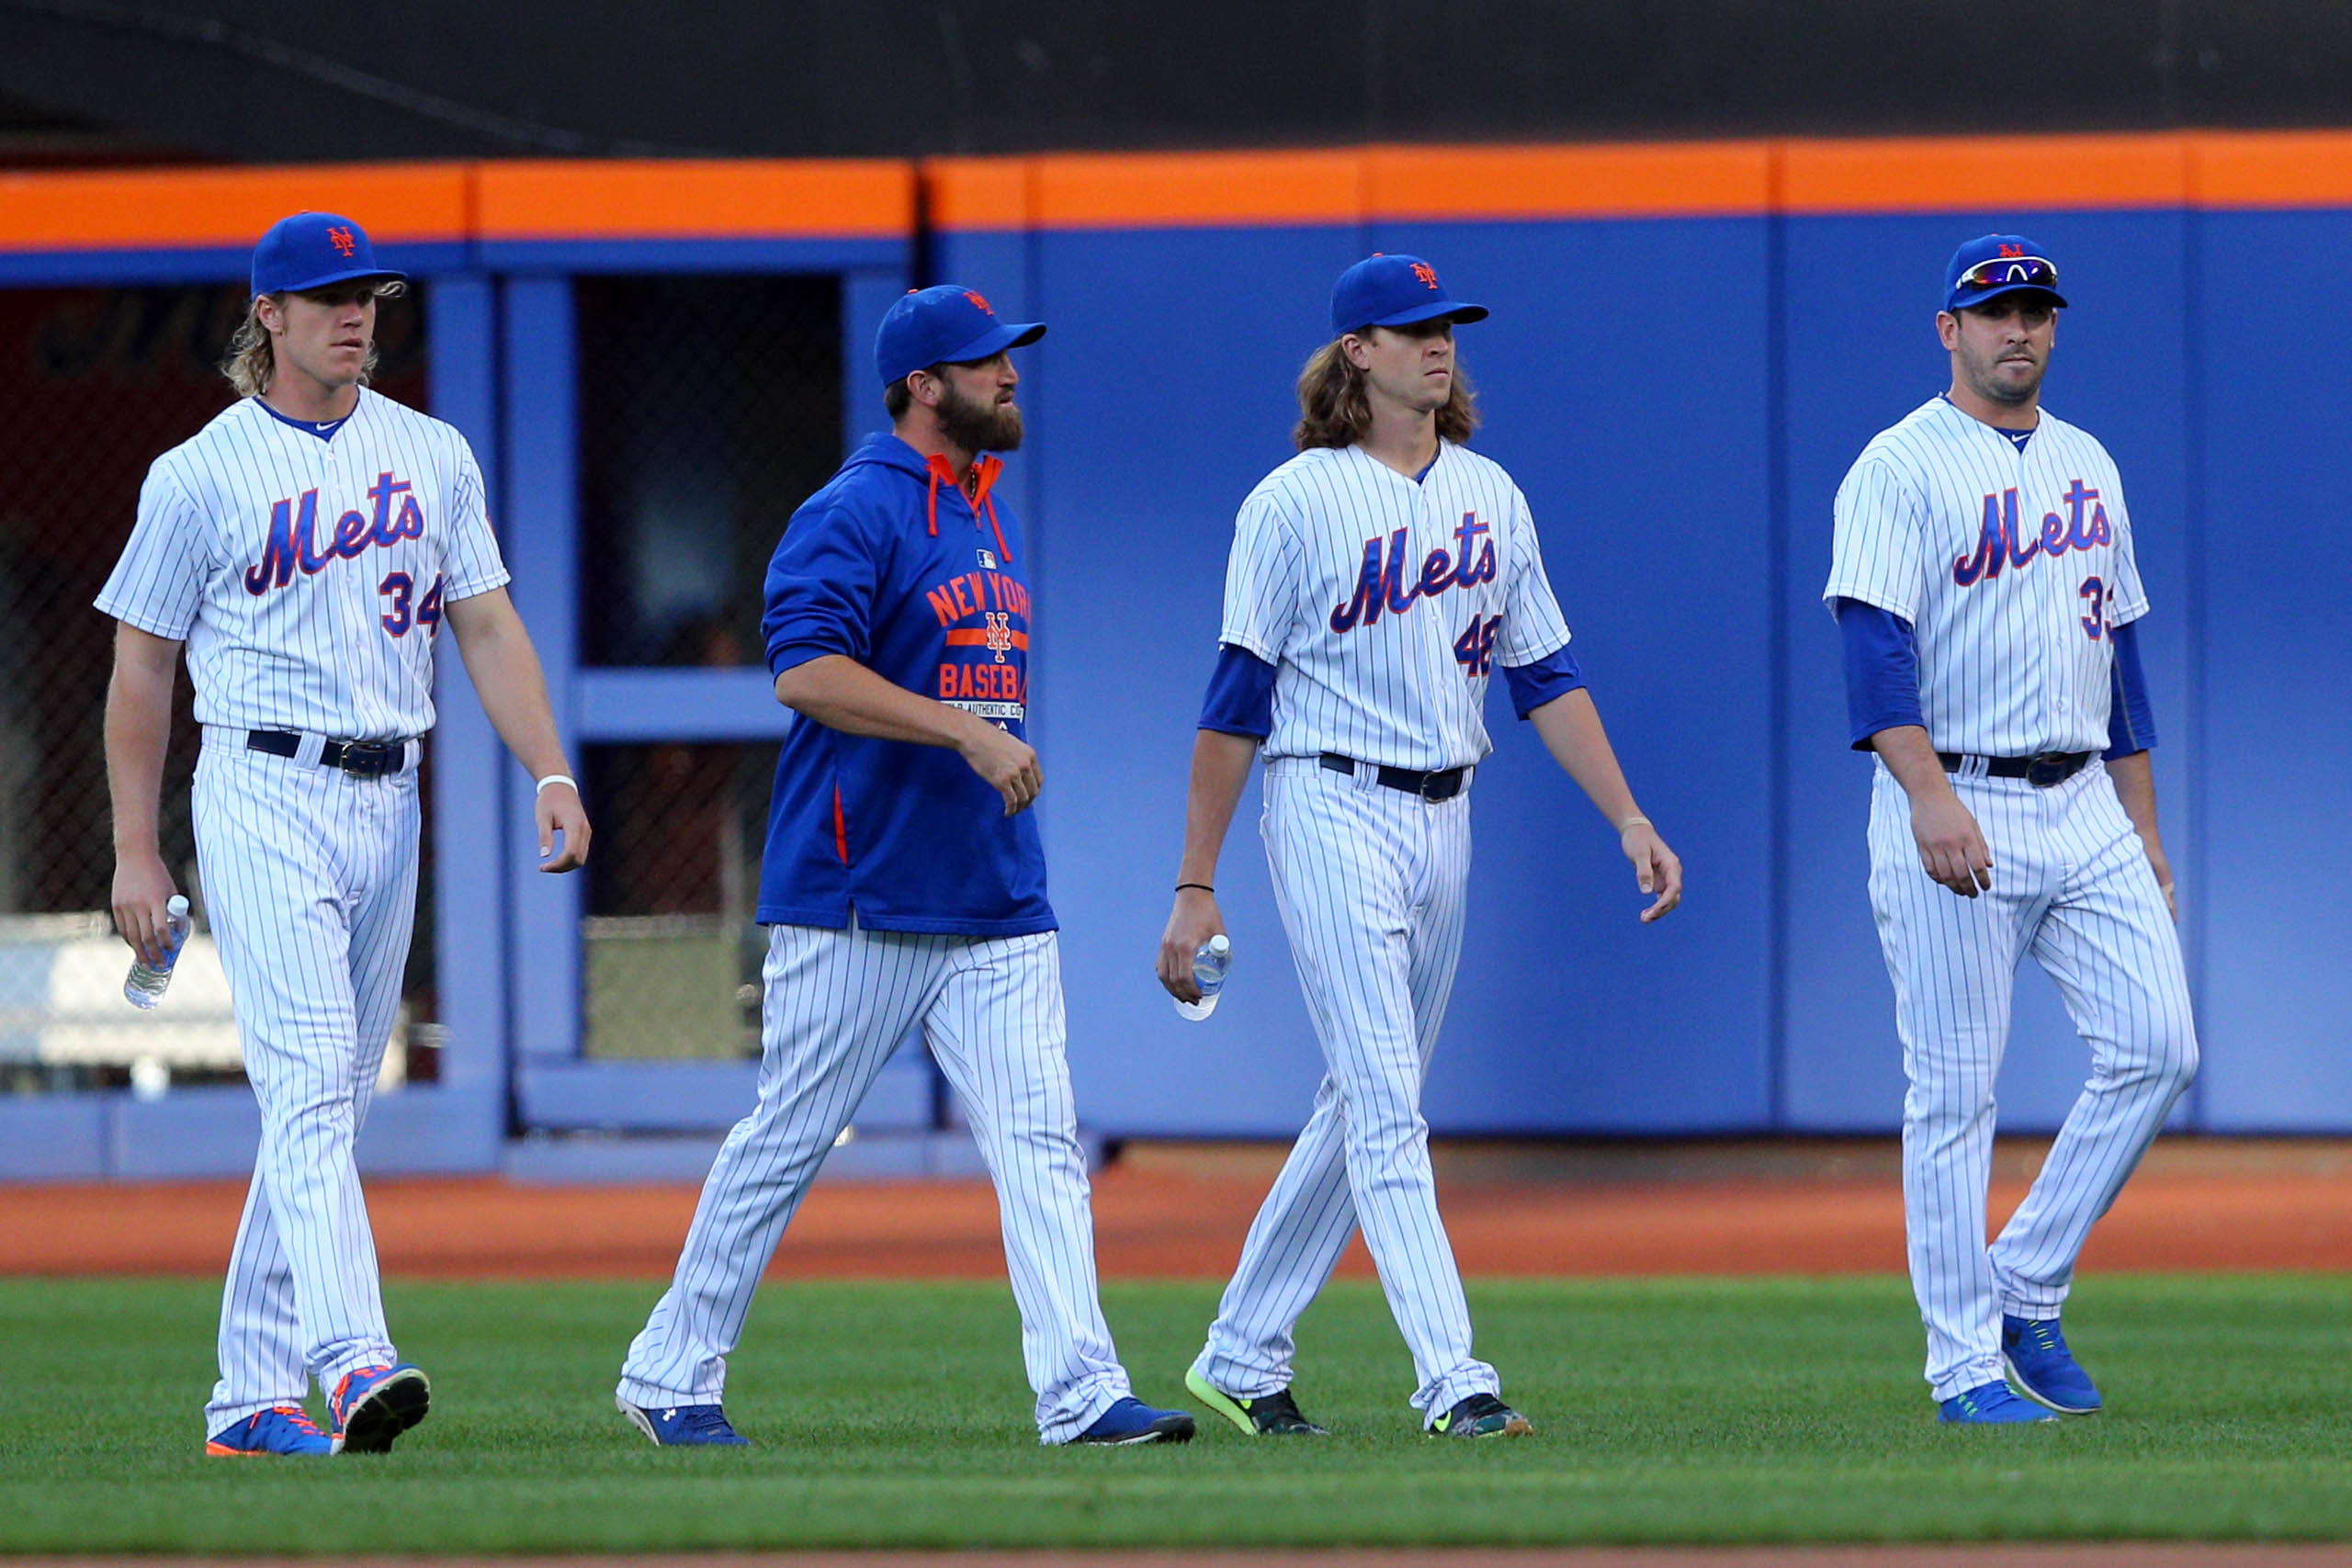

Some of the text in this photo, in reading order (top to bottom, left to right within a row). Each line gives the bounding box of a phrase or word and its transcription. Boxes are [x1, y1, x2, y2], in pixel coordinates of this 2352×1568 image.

[245, 470, 424, 596] Mets
[1953, 479, 2111, 587] Mets
[379, 571, 443, 637] 34
[925, 571, 1031, 627] NEW YOR
[1329, 511, 1497, 634] Mets
[1453, 613, 1504, 677] 48
[967, 703, 1006, 716] AUTHENTIC
